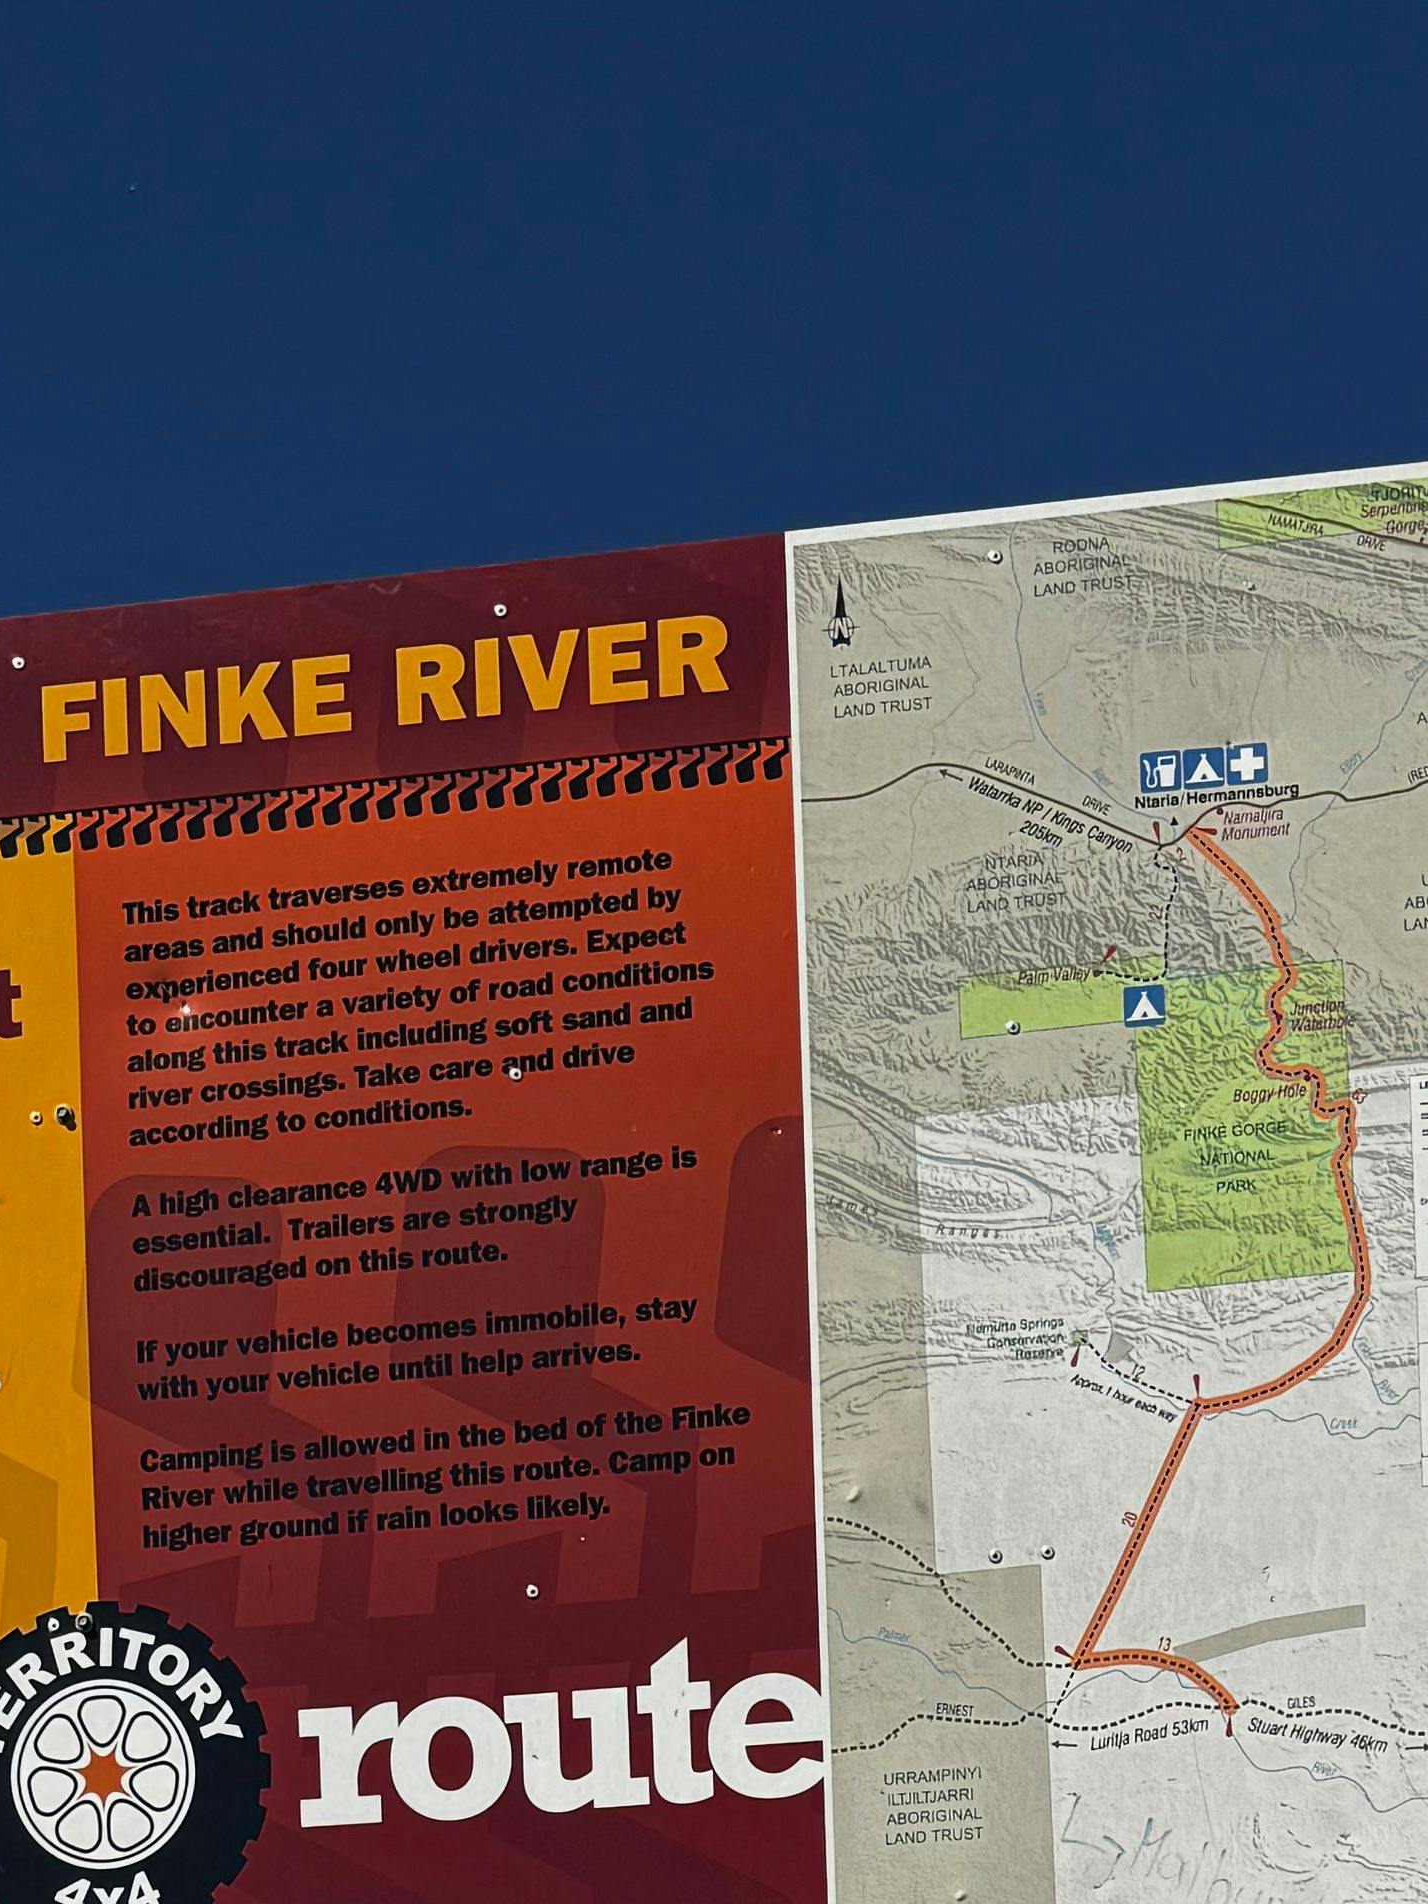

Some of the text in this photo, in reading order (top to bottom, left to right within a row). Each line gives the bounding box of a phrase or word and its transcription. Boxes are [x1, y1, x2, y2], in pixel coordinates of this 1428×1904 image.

[42, 615, 729, 762] FINKE RIVER
[834, 676, 929, 697] ABORIGINAL
[835, 697, 932, 718] LAND TRUST
[122, 849, 672, 924] This track traverses extremely remote
[298, 1637, 825, 1827] route
[1248, 1717, 1389, 1754] Stuart Highway 46km
[887, 1808, 982, 1825] ABORIGINAL
[886, 1827, 983, 1845] LAND TRUST
